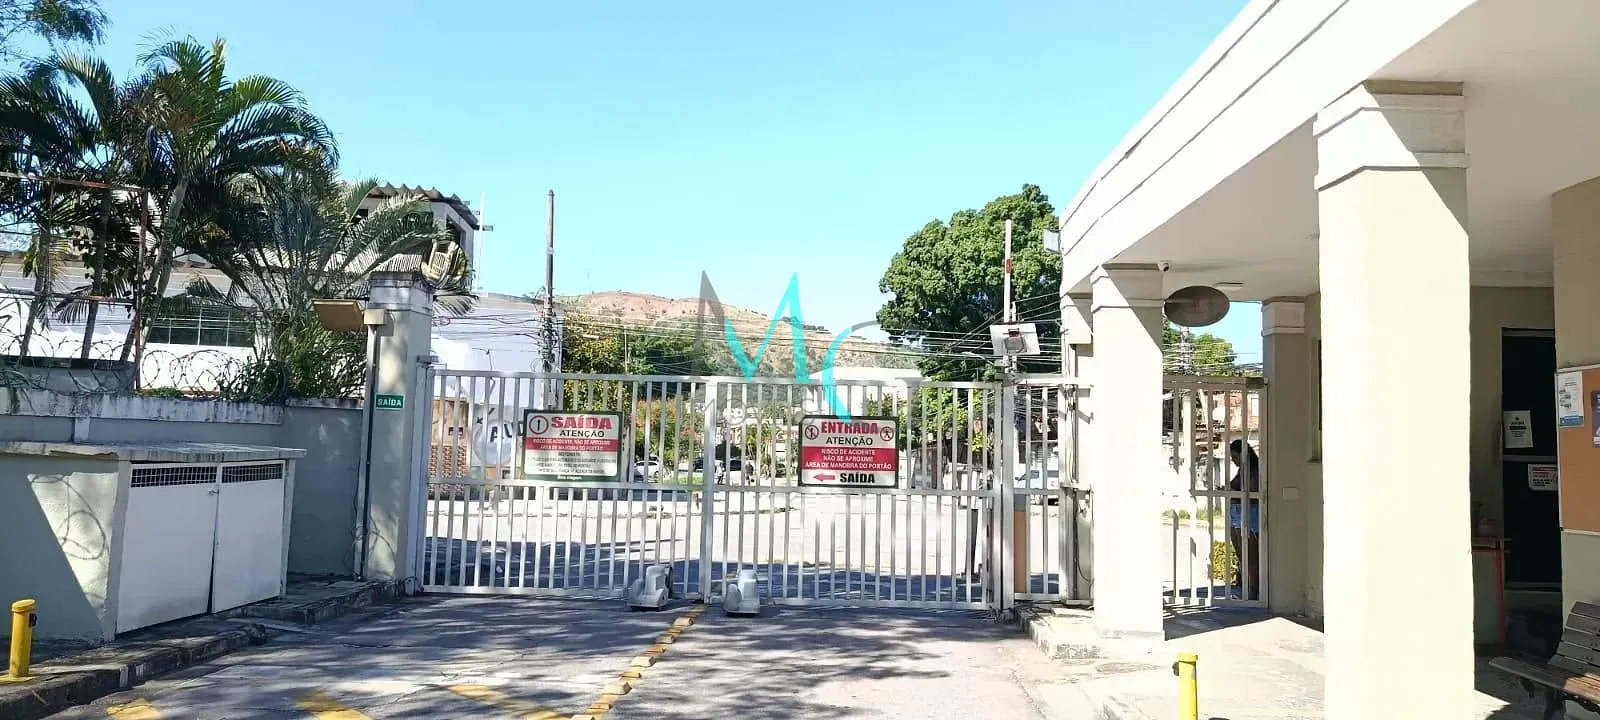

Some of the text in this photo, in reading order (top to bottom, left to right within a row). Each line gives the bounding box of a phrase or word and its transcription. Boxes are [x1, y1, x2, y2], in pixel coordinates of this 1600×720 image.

[377, 397, 402, 406] SAÍDA
[551, 415, 612, 429] SAÍDA
[821, 421, 878, 434] ENTRADA
[559, 429, 605, 438] ATENÇÃO
[825, 436, 873, 446] ATENÇÃO
[840, 472, 875, 484] SAÍDA
